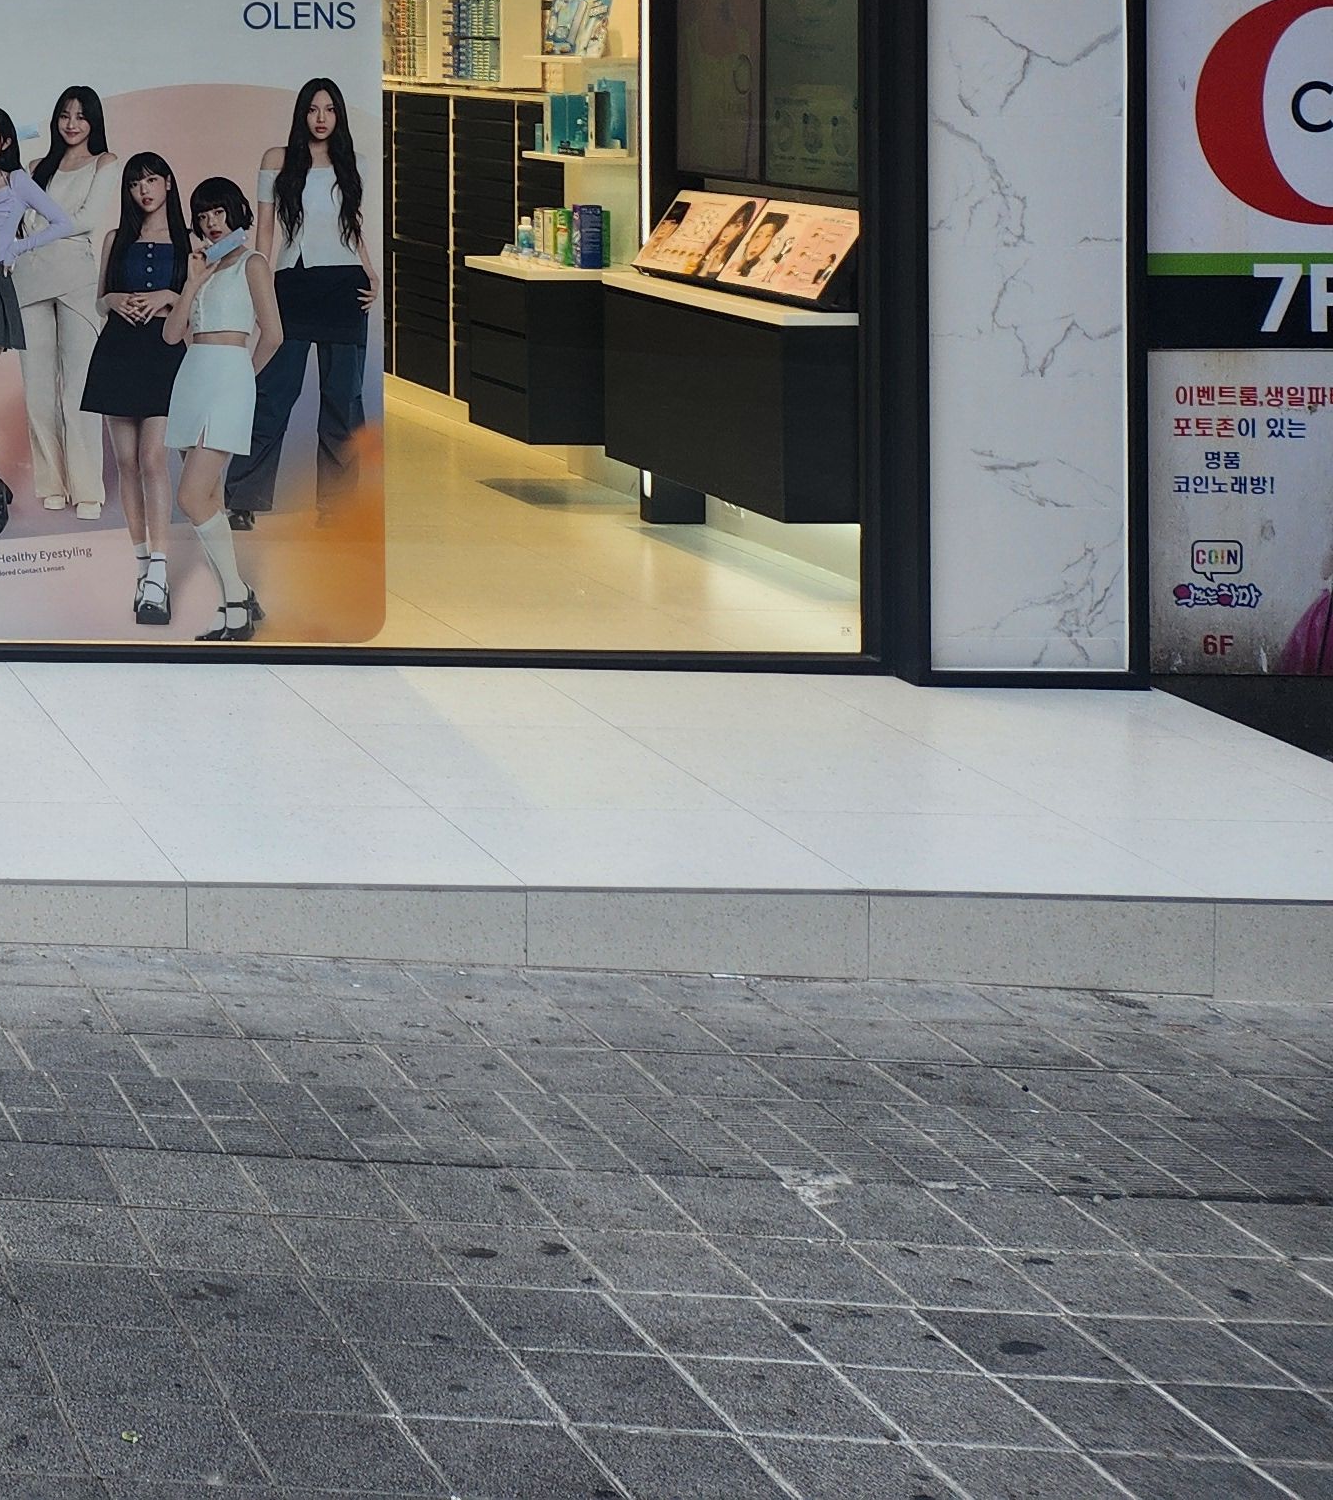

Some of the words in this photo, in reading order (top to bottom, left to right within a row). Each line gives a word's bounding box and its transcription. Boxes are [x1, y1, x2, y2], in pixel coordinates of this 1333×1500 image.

[243, 1, 356, 30] OLENS
[1173, 418, 1258, 439] 포토존이
[1266, 418, 1307, 439] 있는
[1204, 450, 1241, 470] 명품
[1173, 474, 1275, 495] 코인노래방!
[40, 547, 93, 561] Eyestyling
[17, 567, 42, 575] Contact
[43, 565, 65, 573] Lenses
[1203, 634, 1234, 656] 6F
